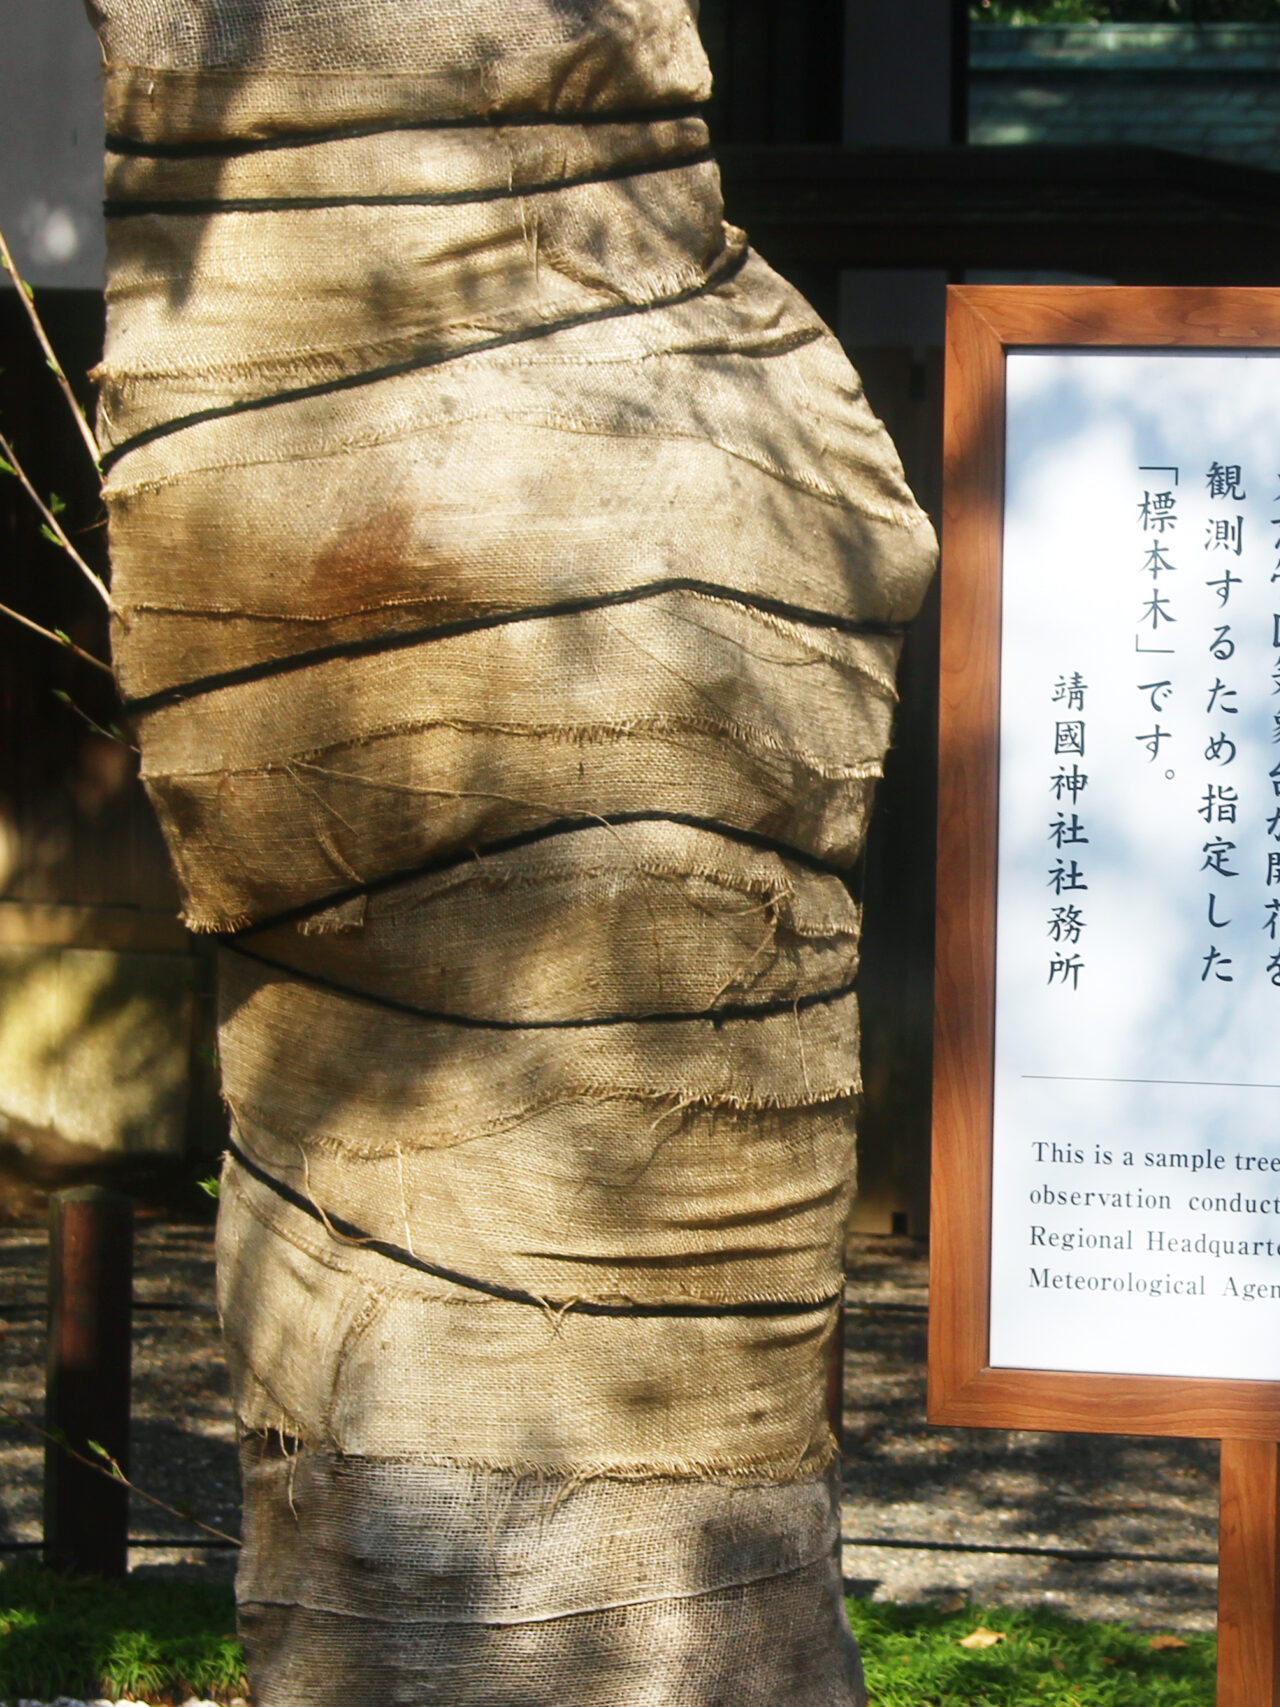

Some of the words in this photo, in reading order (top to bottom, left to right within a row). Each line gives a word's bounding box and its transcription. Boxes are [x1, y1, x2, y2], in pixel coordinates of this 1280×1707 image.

[1196, 460, 1247, 983] 観測するため指定した
[1046, 671, 1090, 992] 靖國神社社務所
[1031, 1141, 1085, 1165] This
[1094, 1143, 1113, 1166] is
[1122, 1151, 1135, 1167] a
[1144, 1148, 1226, 1173] sample
[1029, 1183, 1171, 1210] observation
[1029, 1225, 1133, 1252] Regional
[1029, 1267, 1205, 1297] Meteorological
